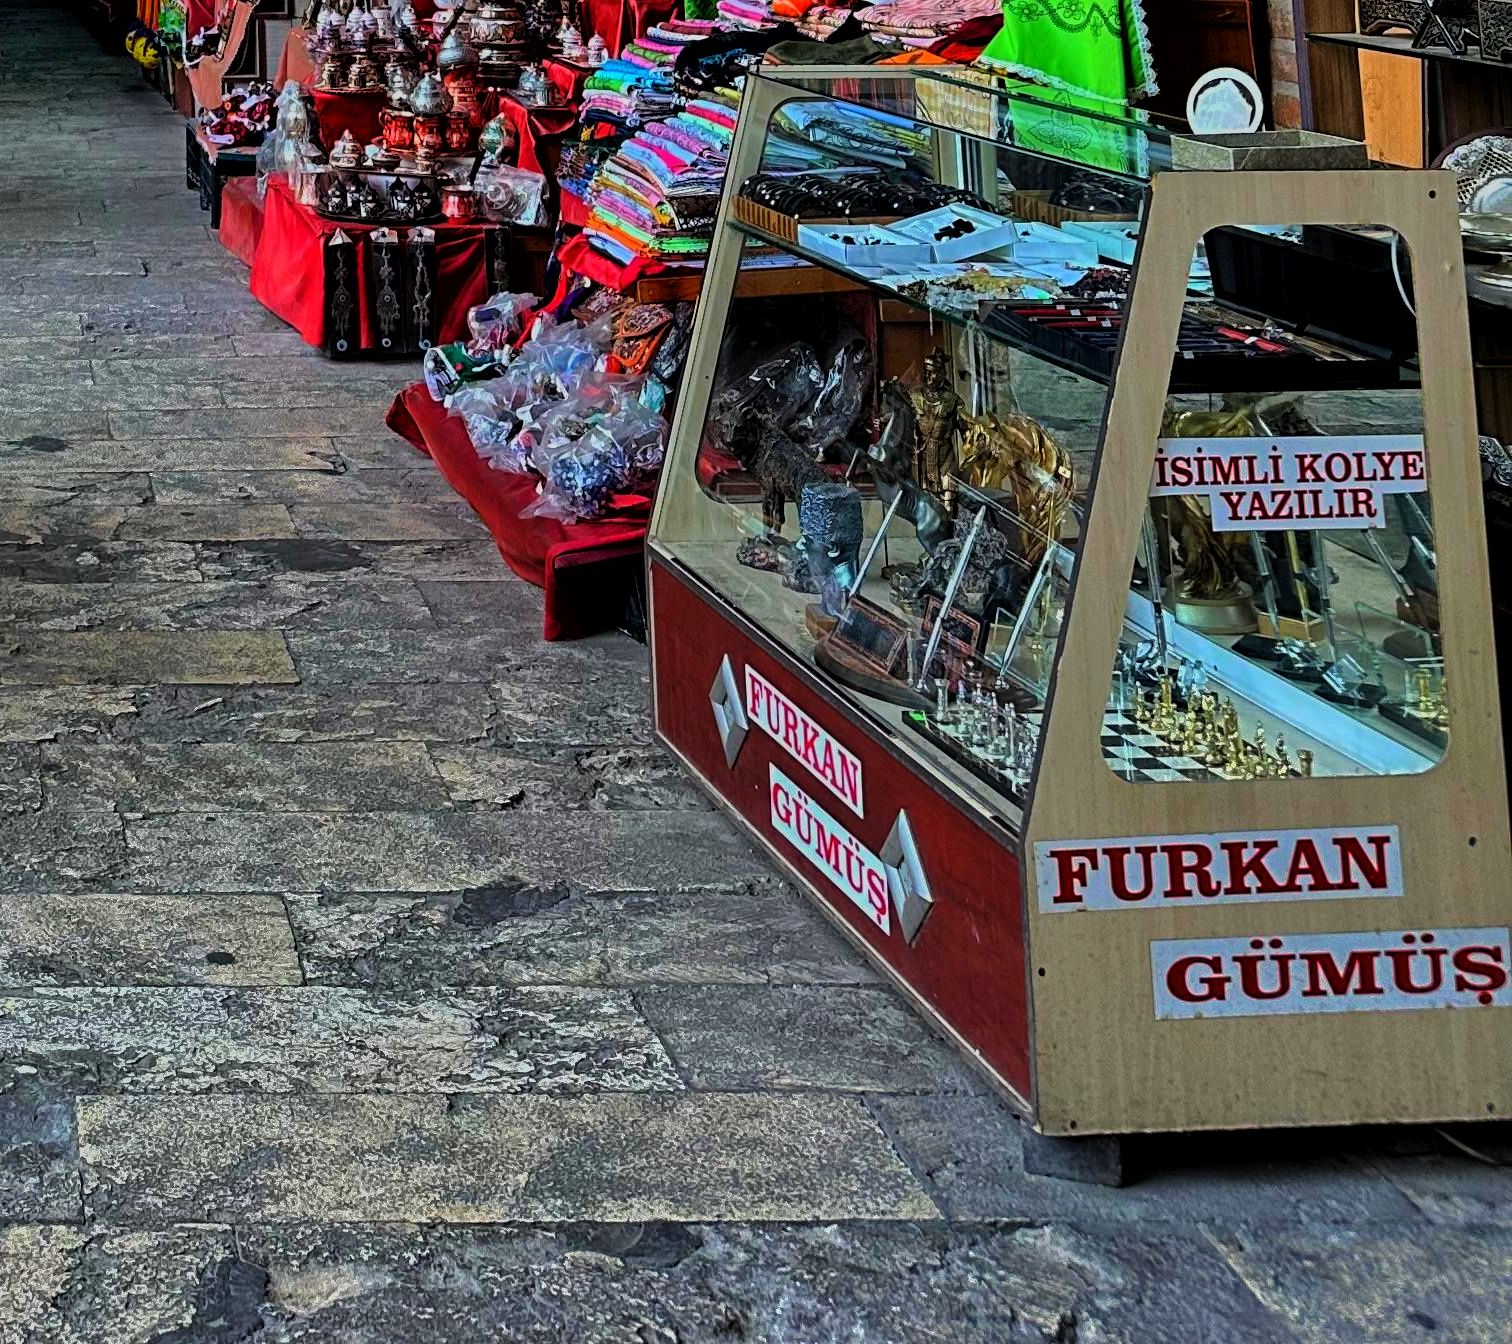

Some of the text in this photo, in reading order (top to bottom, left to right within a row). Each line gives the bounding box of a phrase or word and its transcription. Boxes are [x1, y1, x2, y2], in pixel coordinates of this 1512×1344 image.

[1154, 444, 1425, 487] İSİMLİ KOLYE
[1219, 487, 1378, 521] YAZILIR
[748, 673, 859, 808] FURKAN
[772, 782, 888, 924] GÜMÜŞ
[1049, 835, 1391, 904] FURKAN
[1166, 932, 1507, 1006] GÜMÜŞ
